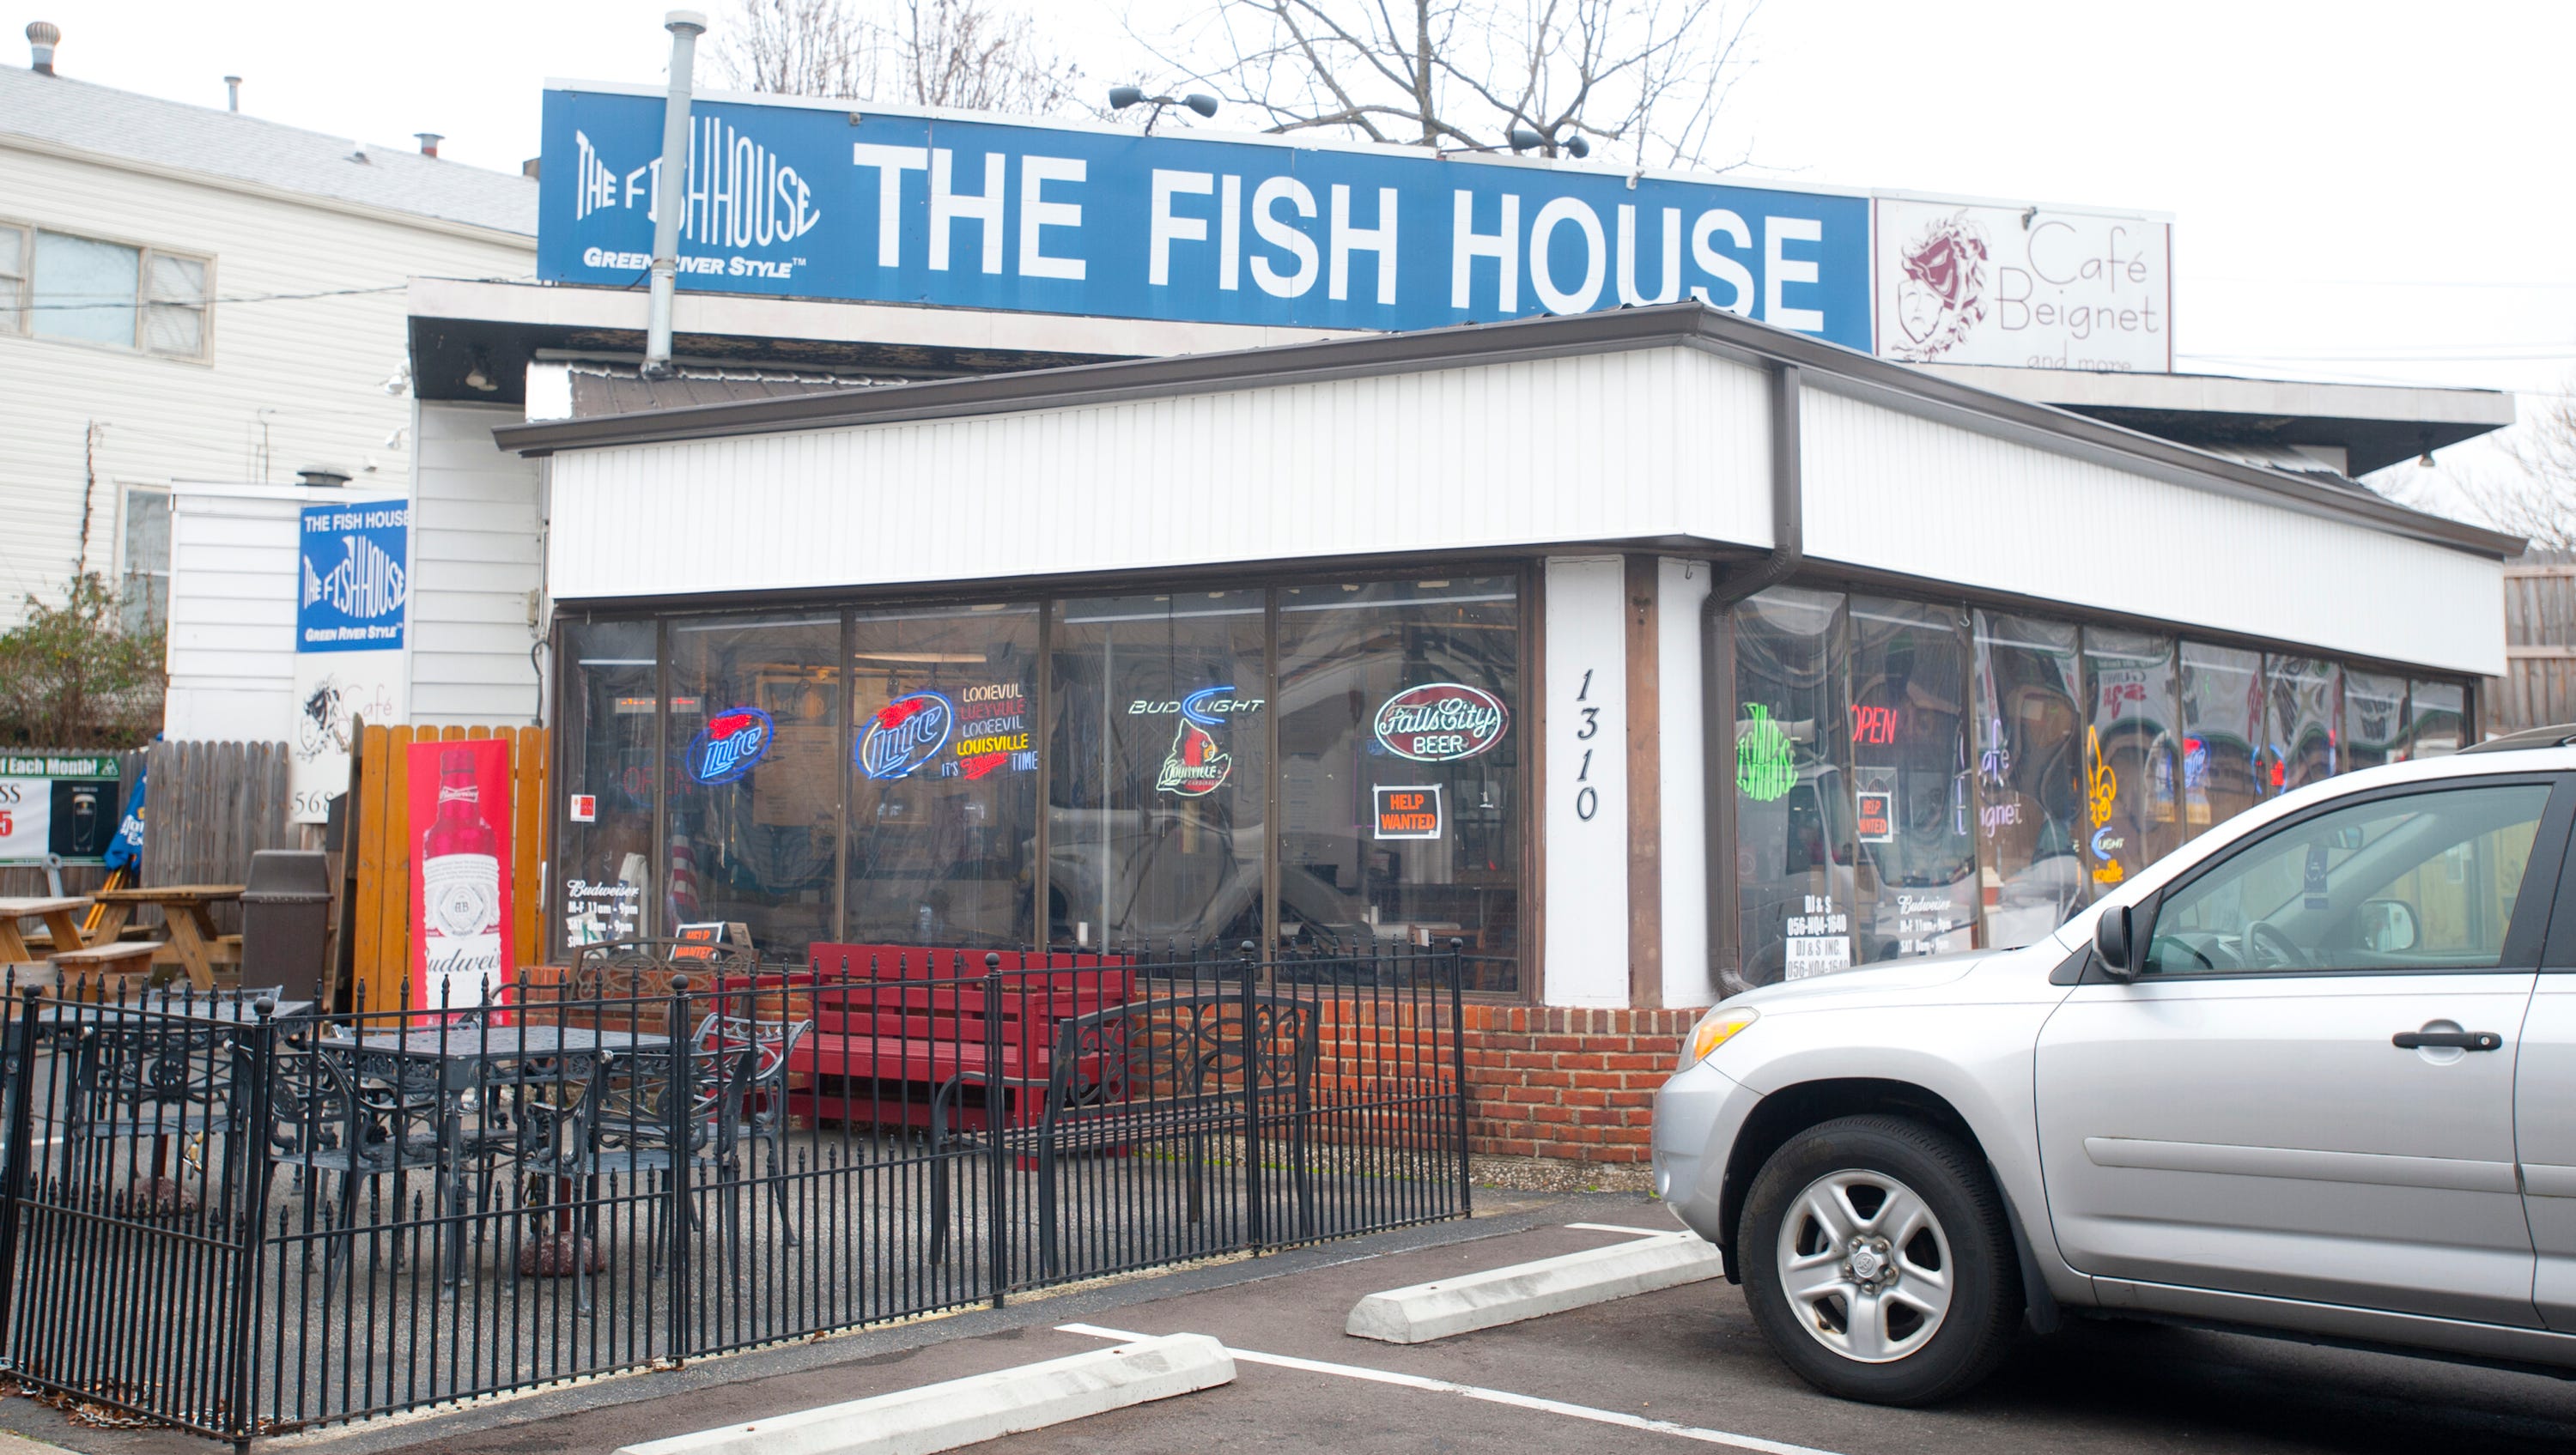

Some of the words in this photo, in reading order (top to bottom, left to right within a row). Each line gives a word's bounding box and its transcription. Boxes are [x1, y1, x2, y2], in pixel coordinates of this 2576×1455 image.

[576, 130, 617, 221] THE
[854, 142, 1086, 281] THE
[1149, 169, 1398, 306] FISH
[1451, 189, 1824, 332] HOUSE
[583, 247, 655, 270] GREEN
[2027, 221, 2147, 294] Café
[1994, 266, 2160, 340] Beignet
[2027, 339, 2068, 370] and
[2078, 356, 2132, 372] more
[305, 515, 331, 533] THE
[332, 512, 363, 530] FISH
[303, 553, 323, 609] THE
[305, 627, 337, 642] GREEN
[338, 626, 368, 640] RIVER
[341, 683, 392, 724] Café
[1128, 700, 1182, 714] BUD
[1194, 699, 1266, 712] LIGHT
[1378, 703, 1441, 736] Falls
[1437, 697, 1498, 738] City
[1851, 704, 1898, 745] OPEN
[700, 726, 762, 779] Lite
[869, 705, 943, 780] Lite
[957, 733, 1030, 756] LOUISVILLE
[1413, 735, 1464, 755] BEER
[1576, 669, 1601, 822] 1310
[9, 757, 44, 775] Each
[46, 757, 98, 776] Month!
[941, 761, 959, 777] IT'S
[1012, 750, 1038, 772] TIME
[1390, 793, 1425, 810] HELP
[1862, 799, 1882, 815] HELP
[1381, 814, 1437, 831] WANTED
[567, 879, 640, 898] Budweiser
[568, 900, 585, 914] M-F
[587, 901, 611, 915] 11am
[619, 902, 638, 917] 9pm
[1825, 895, 1832, 914] S
[568, 918, 585, 931] SAT
[614, 919, 634, 935] 9pm
[1815, 939, 1821, 956] S
